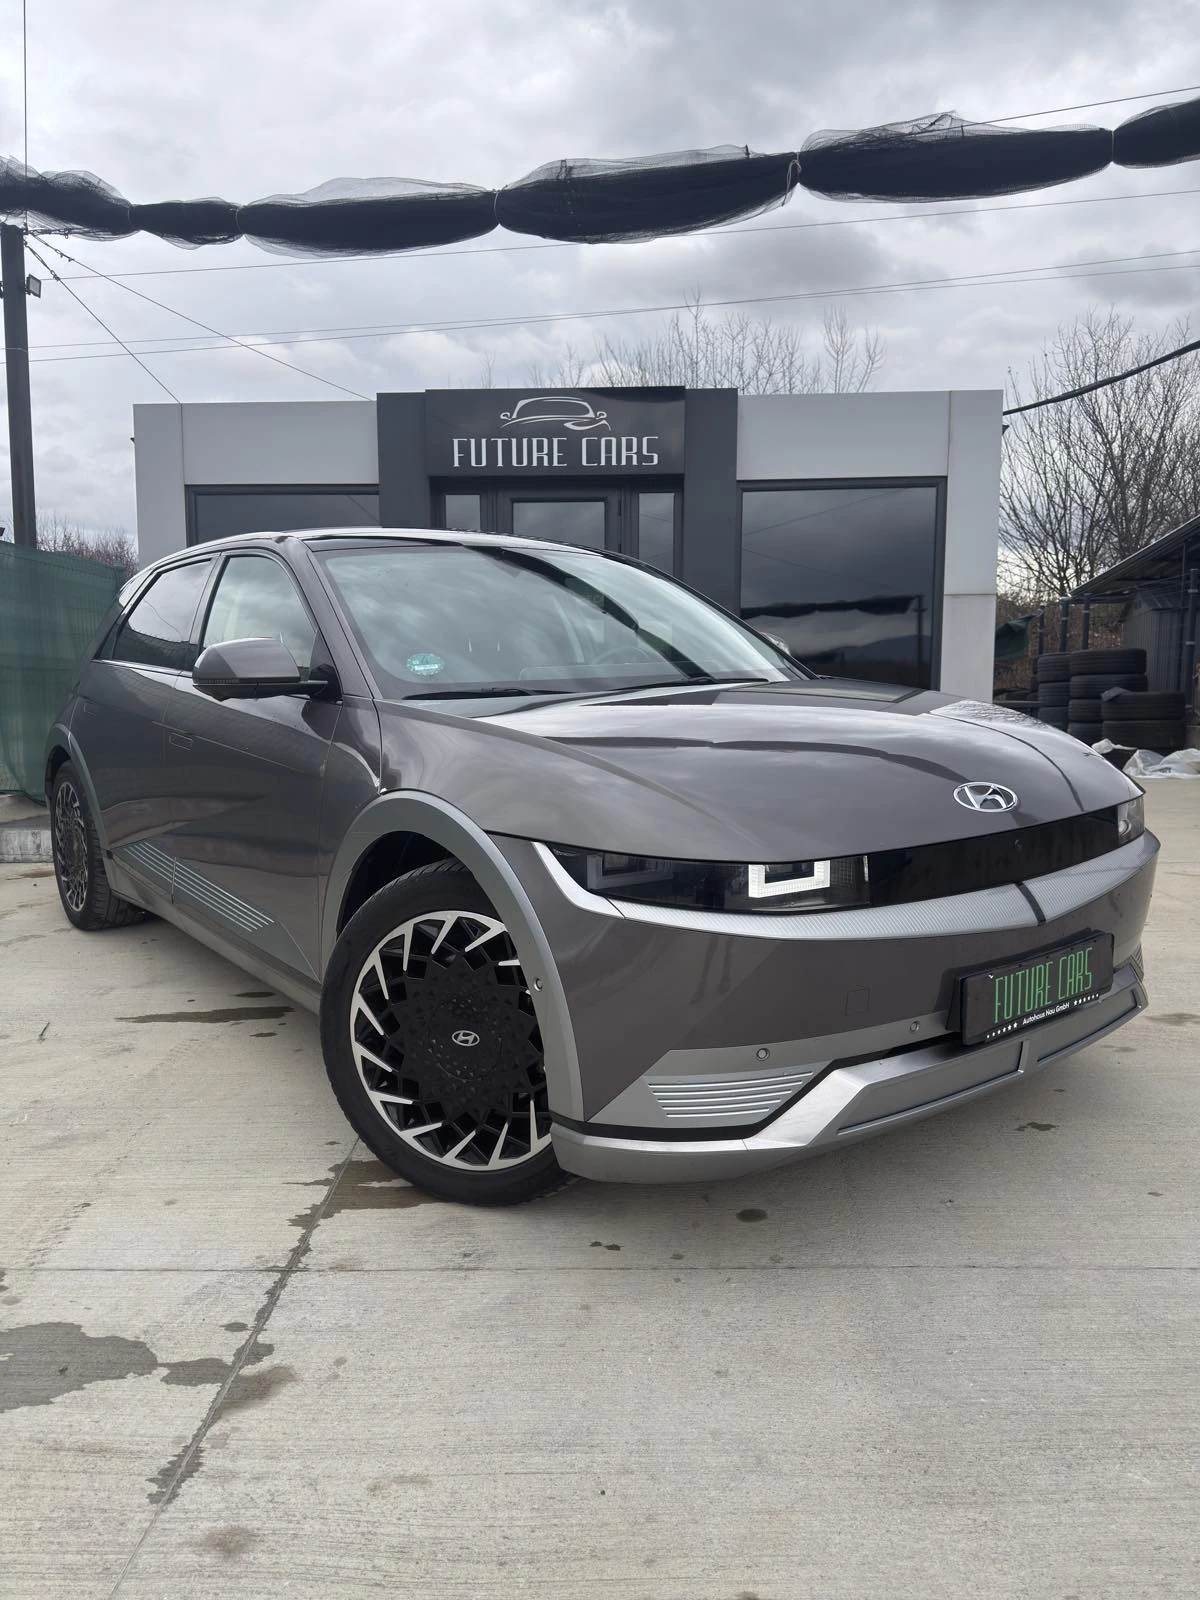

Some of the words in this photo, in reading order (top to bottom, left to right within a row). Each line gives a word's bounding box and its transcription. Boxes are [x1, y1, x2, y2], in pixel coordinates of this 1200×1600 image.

[452, 437, 568, 467] FUTURE
[581, 436, 659, 466] CARS
[994, 961, 1054, 1024] FUTURE
[1058, 947, 1093, 1000] CARS
[1022, 1011, 1046, 1025] Autohaus
[1055, 1002, 1070, 1013] GmbH
